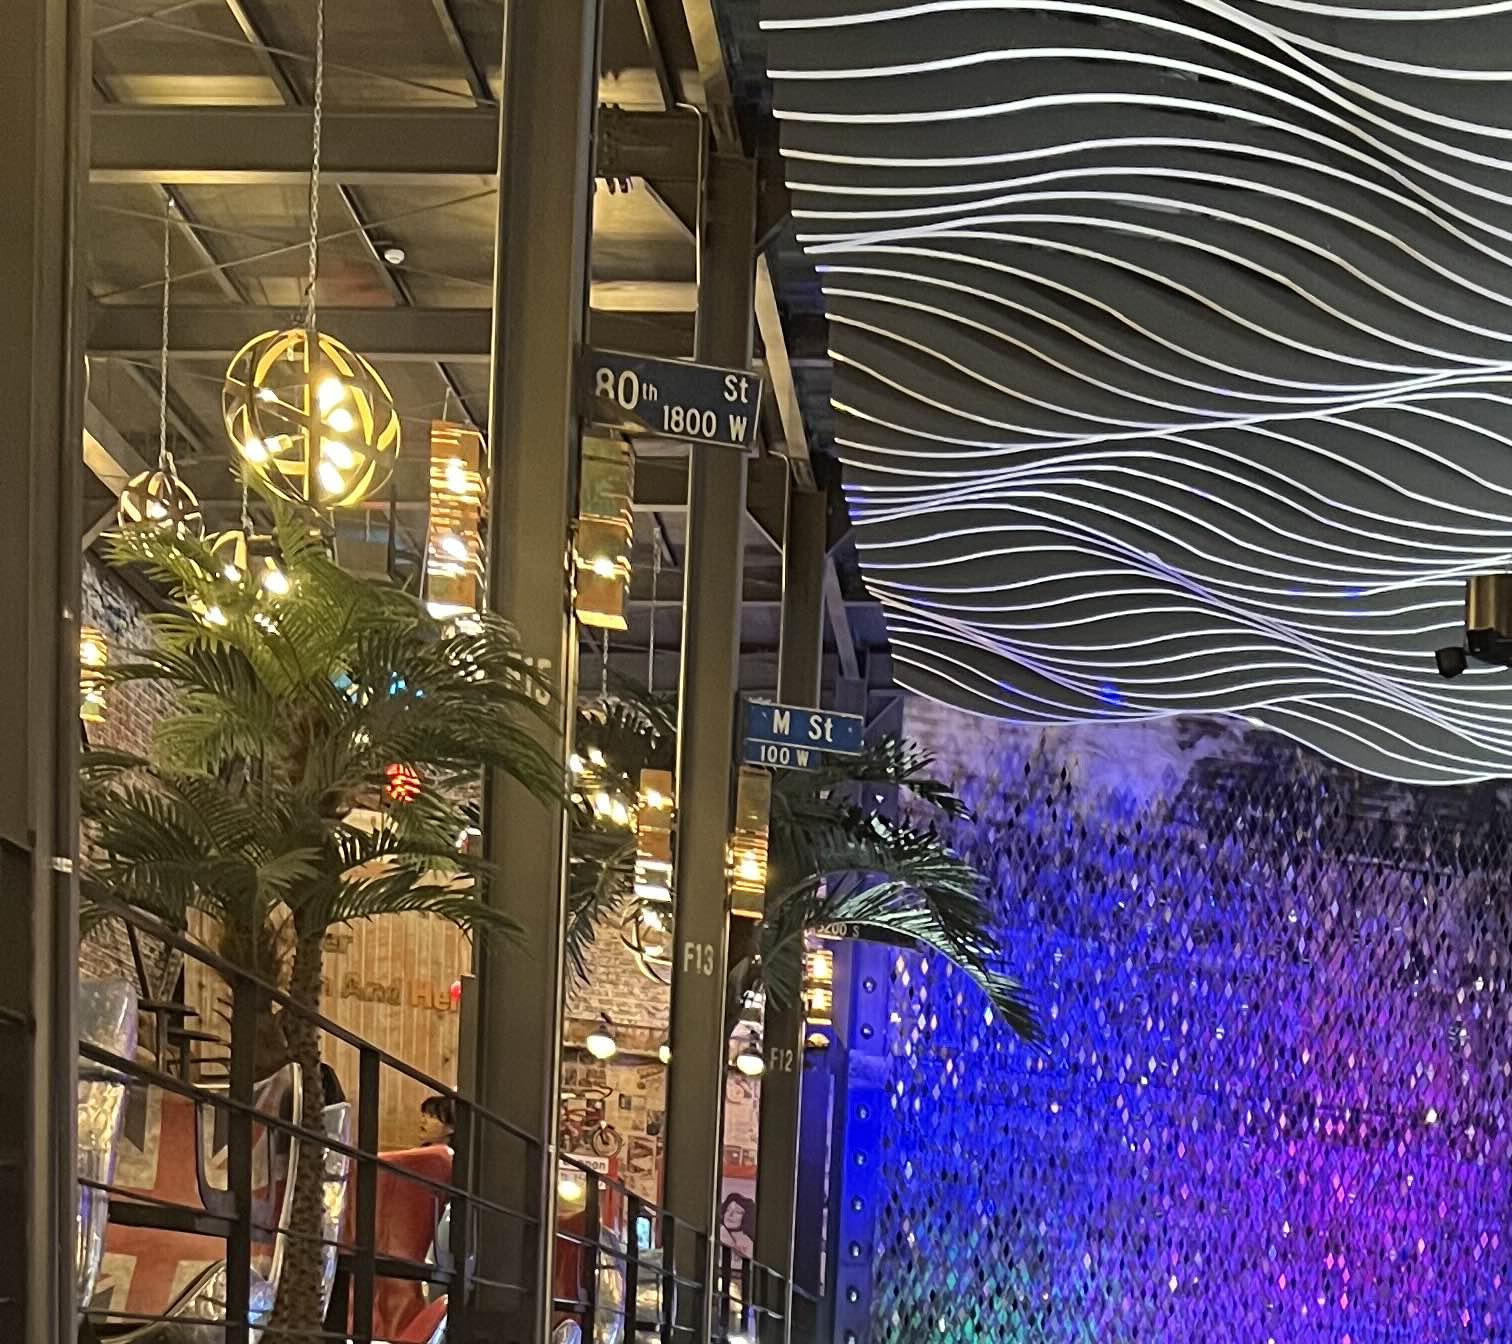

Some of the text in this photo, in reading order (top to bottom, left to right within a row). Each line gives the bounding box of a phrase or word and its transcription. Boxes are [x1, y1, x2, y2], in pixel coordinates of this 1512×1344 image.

[595, 367, 748, 410] 80th St
[664, 405, 747, 442] 1800 W
[773, 709, 833, 742] M St
[760, 744, 809, 768] 100 W
[684, 942, 714, 976] F13
[769, 1047, 793, 1073] F12
